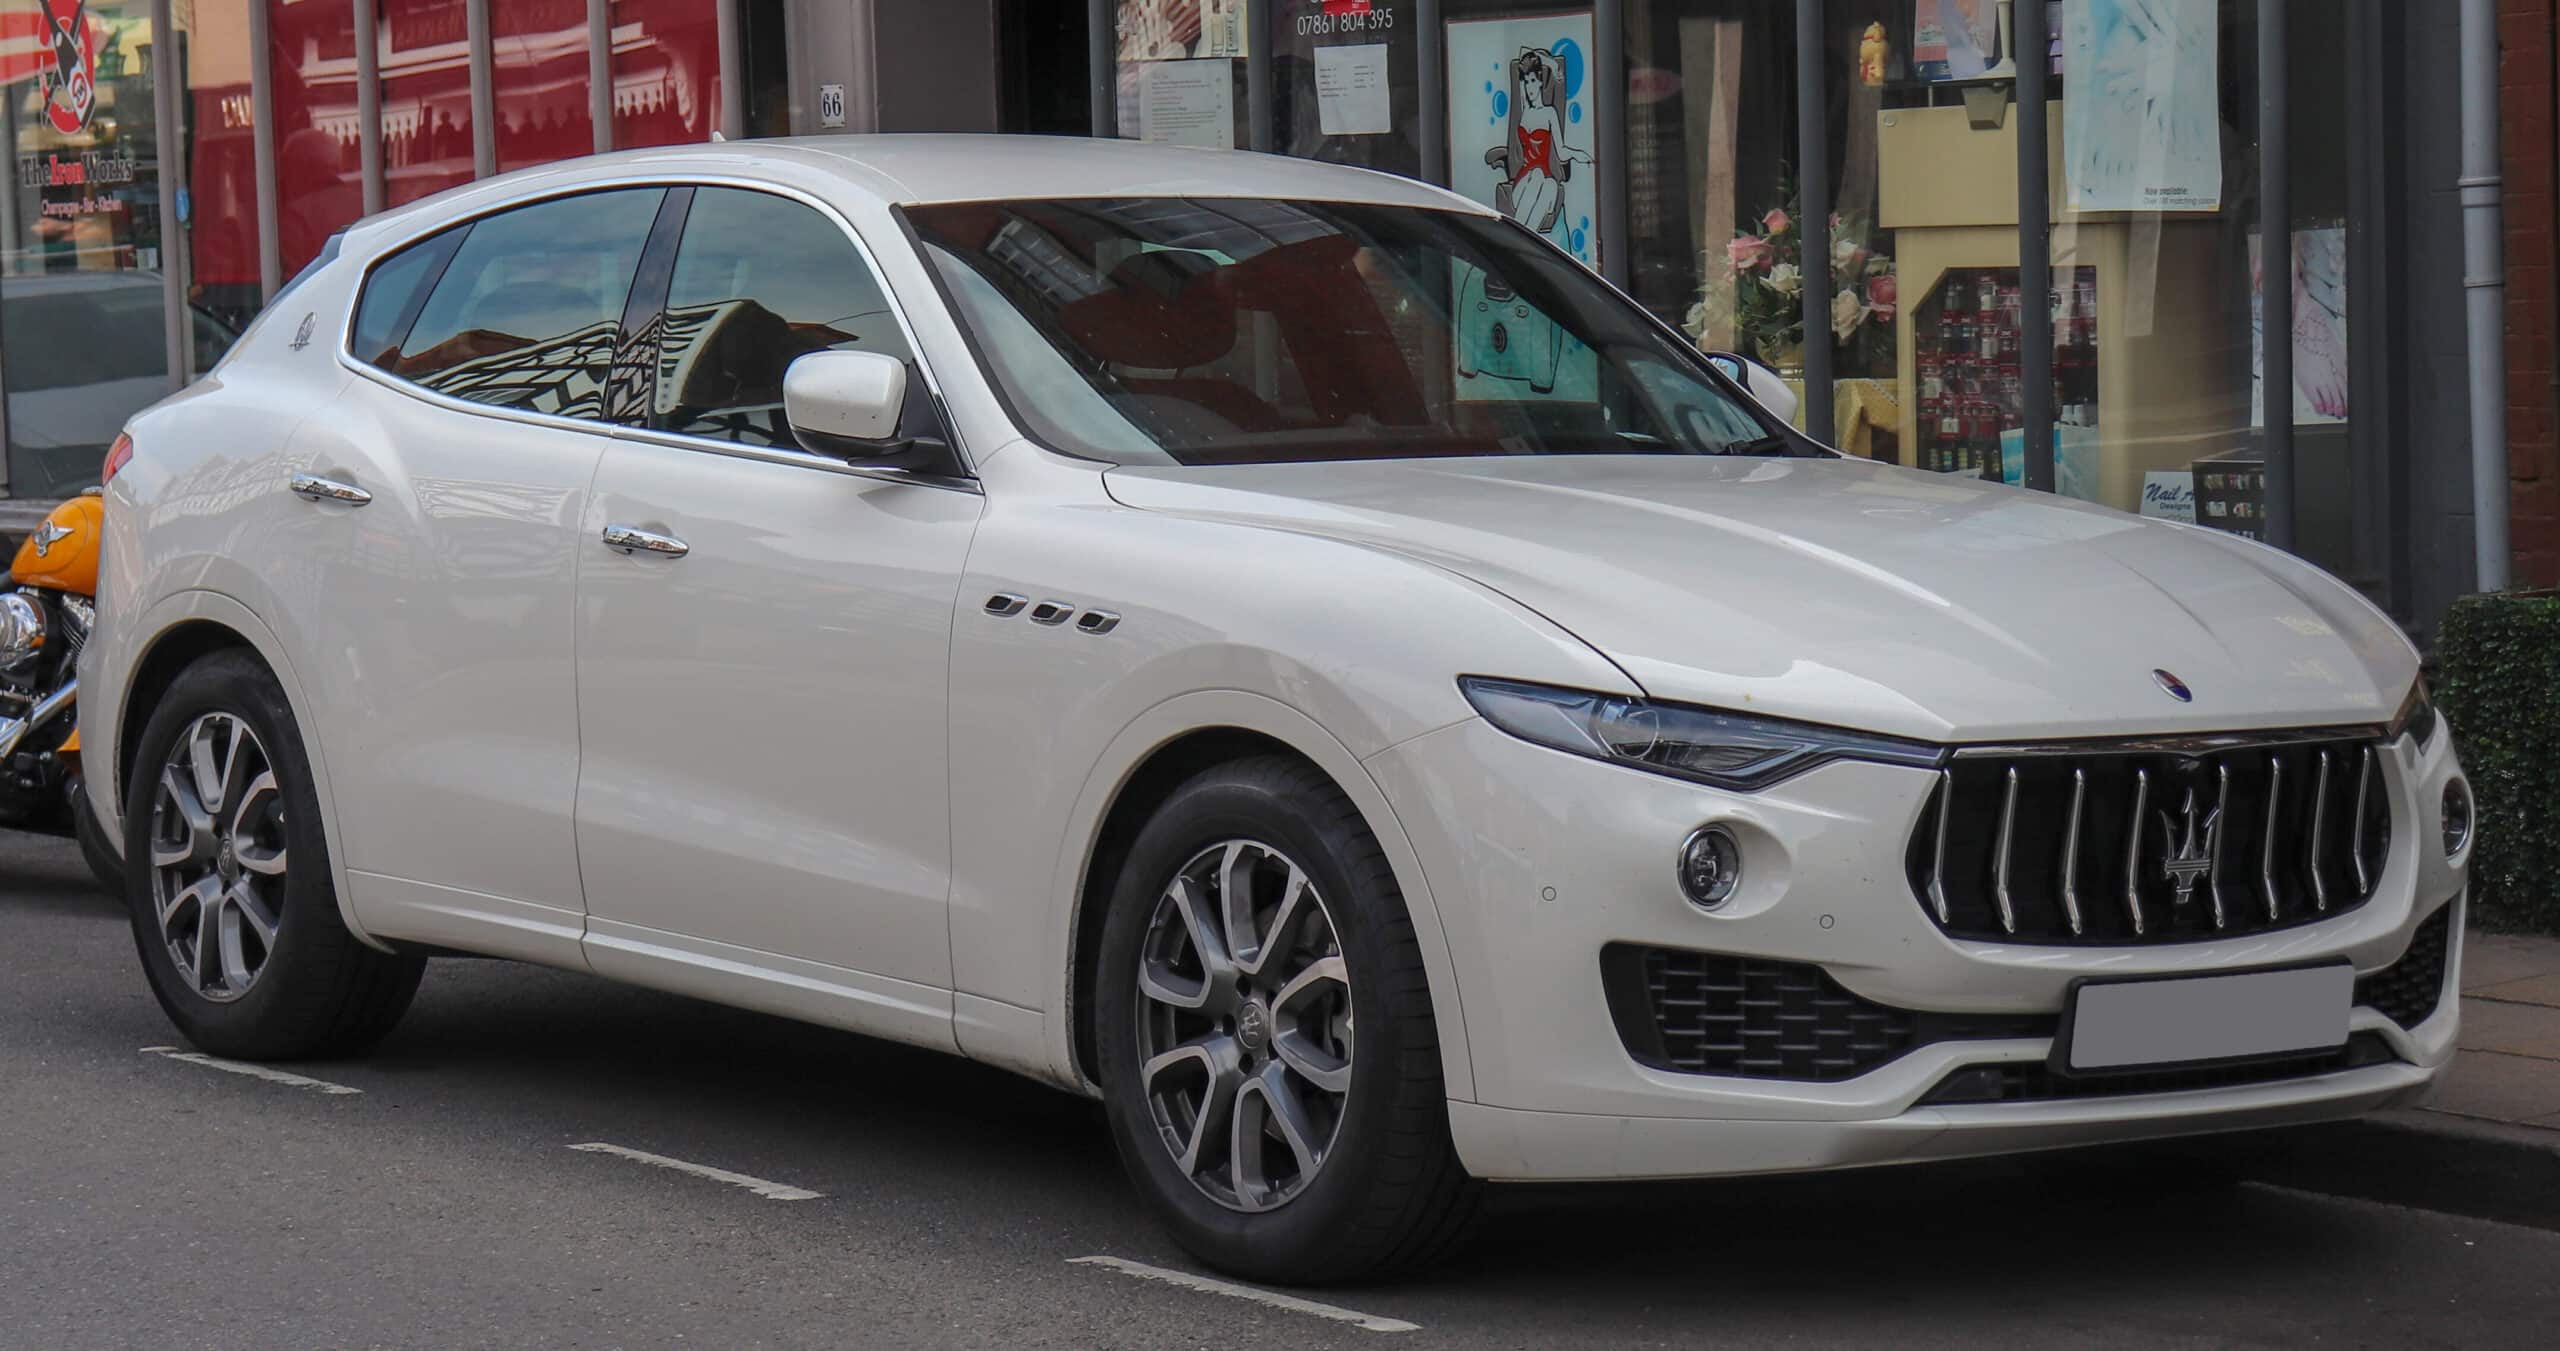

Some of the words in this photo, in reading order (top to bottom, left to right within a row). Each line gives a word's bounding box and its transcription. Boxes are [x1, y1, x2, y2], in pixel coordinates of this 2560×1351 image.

[1297, 14, 1335, 36] 07861
[1340, 11, 1365, 32] 804
[1369, 8, 1393, 29] 395
[823, 92, 842, 117] 66
[2146, 482, 2181, 502] Nail
